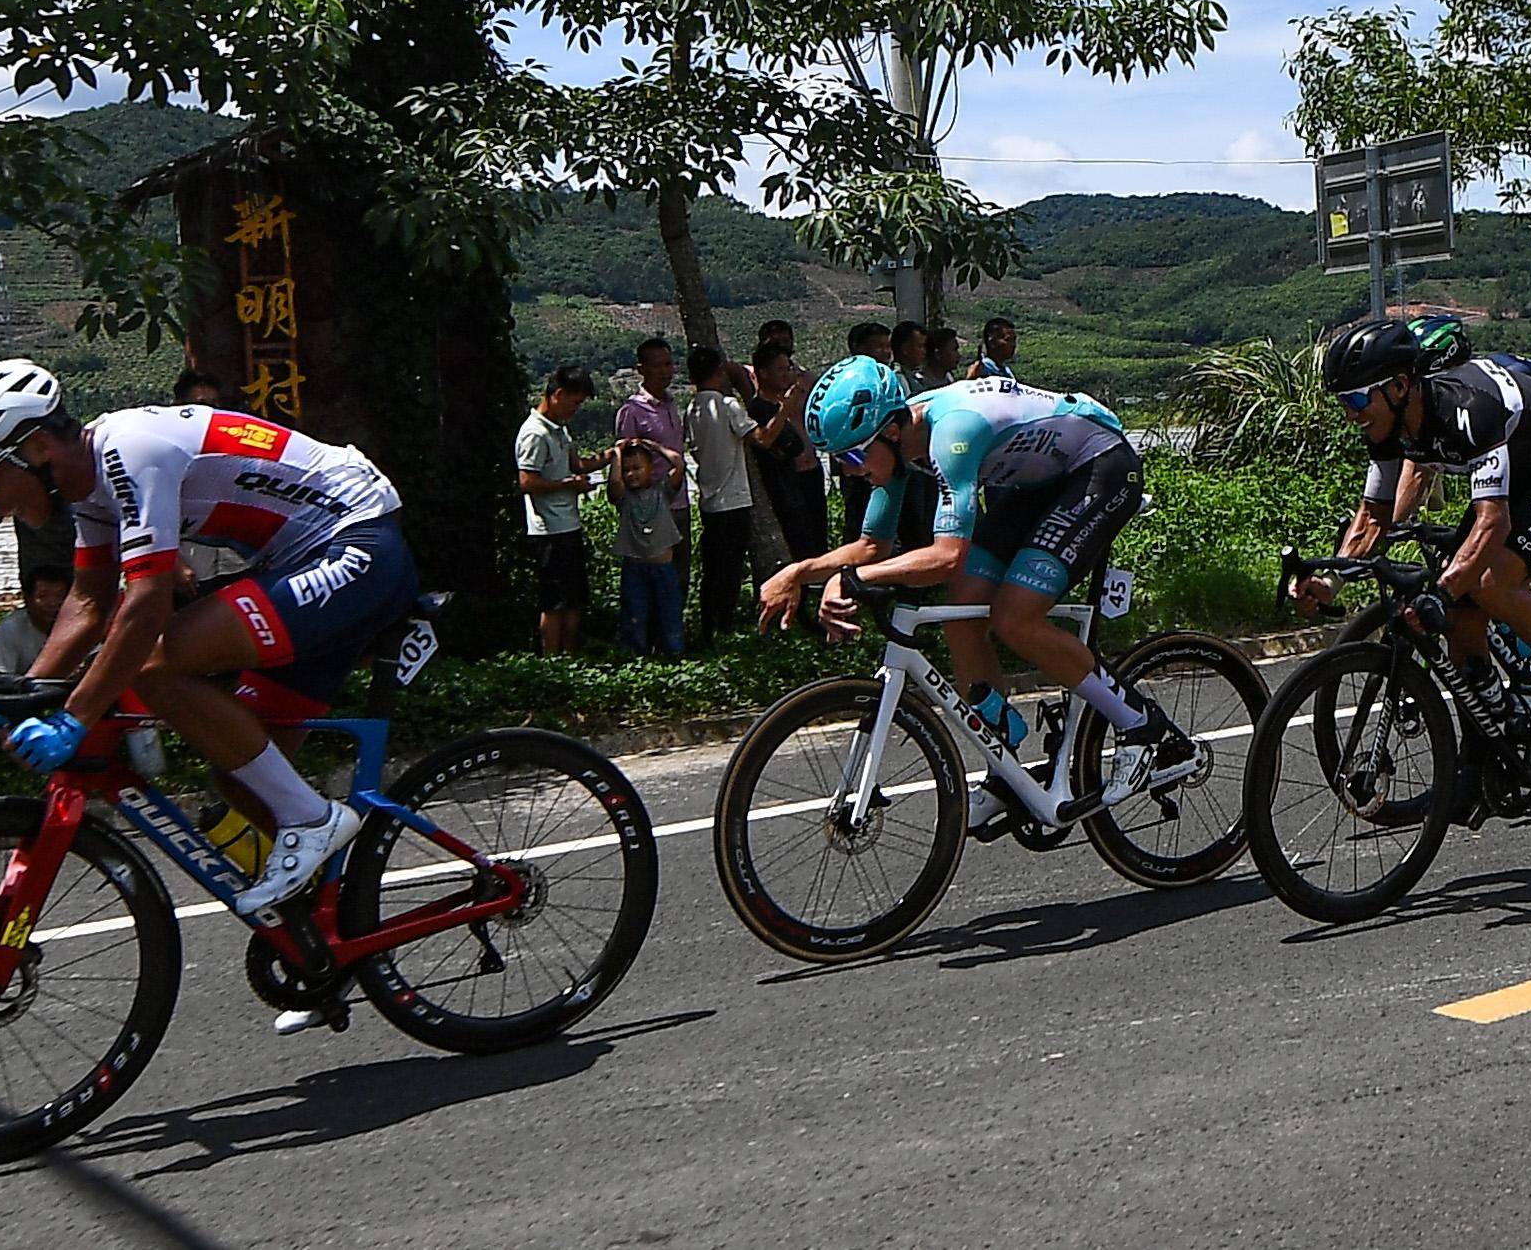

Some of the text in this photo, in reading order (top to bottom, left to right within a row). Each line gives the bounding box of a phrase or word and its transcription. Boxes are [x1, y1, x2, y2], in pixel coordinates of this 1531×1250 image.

[224, 196, 306, 419] 新明村
[1060, 511, 1104, 564] BARDIANI
[1105, 487, 1132, 513] CSF
[1110, 580, 1127, 609] 45
[398, 629, 432, 677] 105
[924, 669, 1004, 761] DE ROSA
[119, 787, 283, 928] QUICKPO
